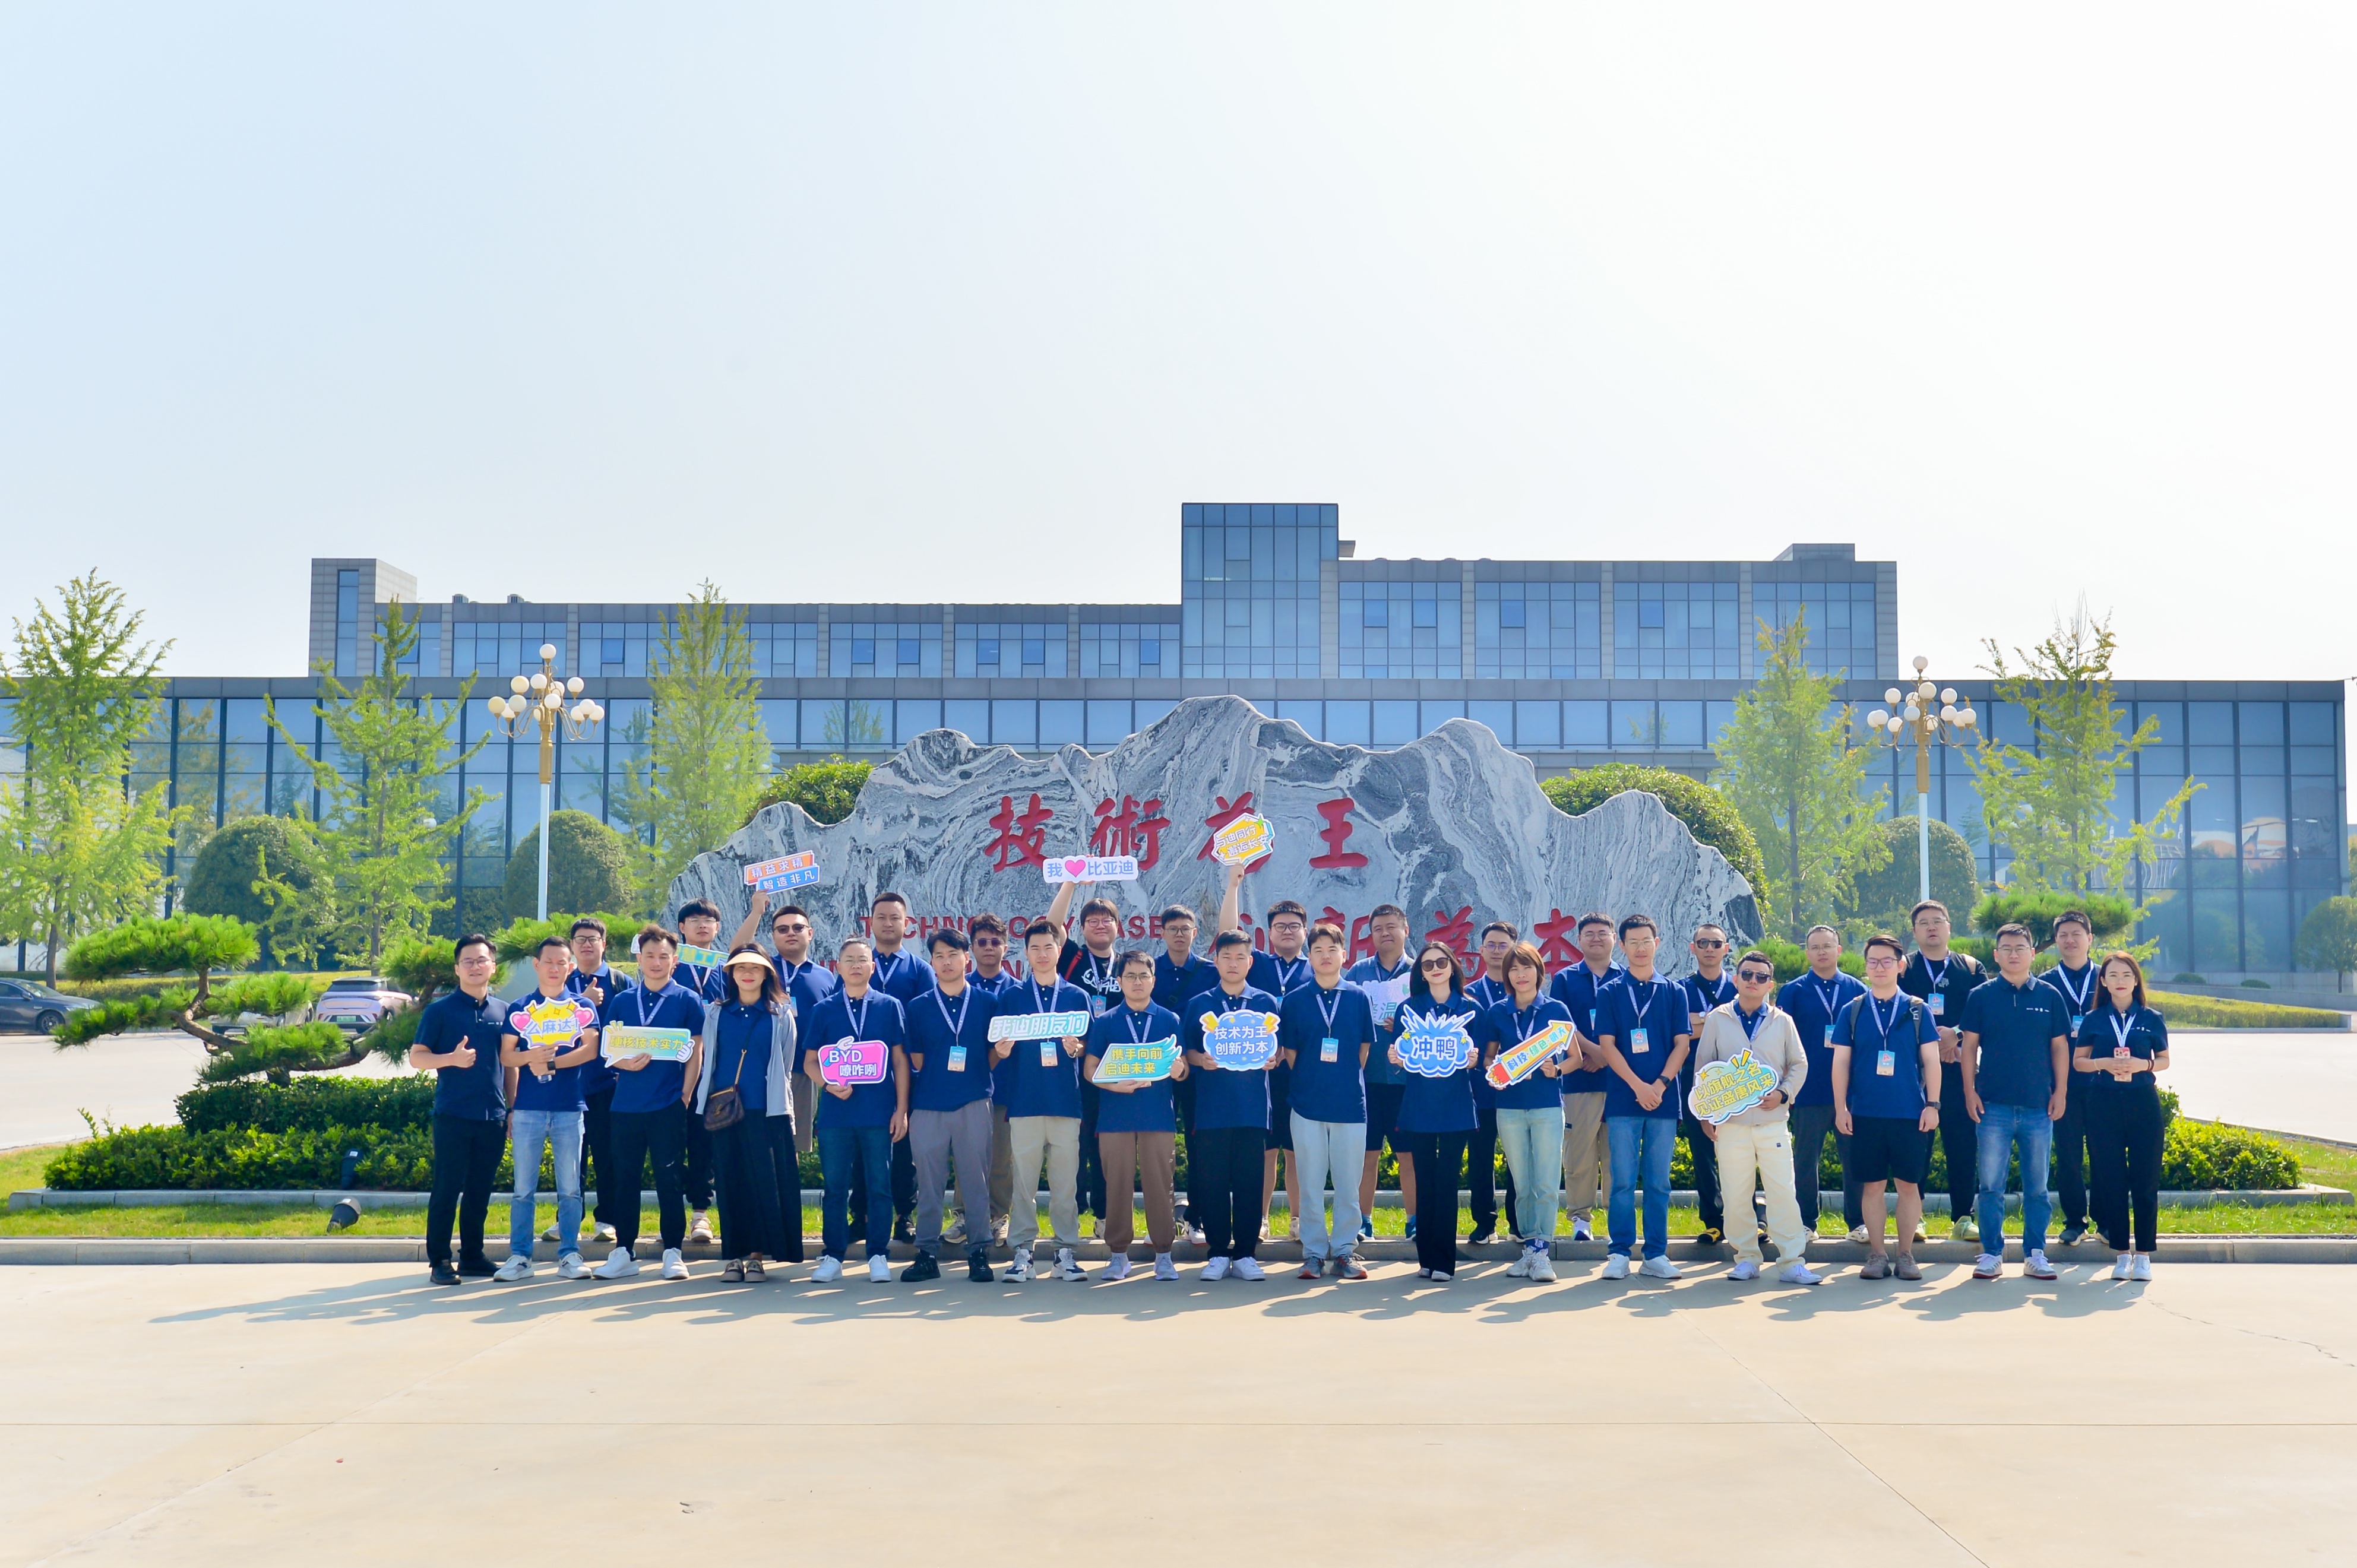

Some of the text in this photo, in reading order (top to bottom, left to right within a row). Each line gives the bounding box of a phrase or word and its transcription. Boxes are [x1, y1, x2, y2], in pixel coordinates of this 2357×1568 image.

[1216, 825, 1256, 847] 与迪同行
[751, 857, 803, 878] 精益求精
[1047, 860, 1134, 878] 我 比亚迪
[763, 870, 815, 890] 智造非凡
[991, 1015, 1086, 1037] 我迪朋友们
[1214, 1025, 1268, 1040] 技术为王
[610, 1035, 683, 1050] 硬核技术实力
[1215, 1040, 1268, 1055] 创新为本
[1413, 1037, 1456, 1058] 冲鸭
[829, 1050, 862, 1063] BYD
[1111, 1047, 1162, 1060] 携手向前
[1105, 1062, 1156, 1075] 启迪未来
[1694, 1062, 1763, 1100] 以旗舰之名
[1695, 1073, 1776, 1117] 见证盛唐风采
